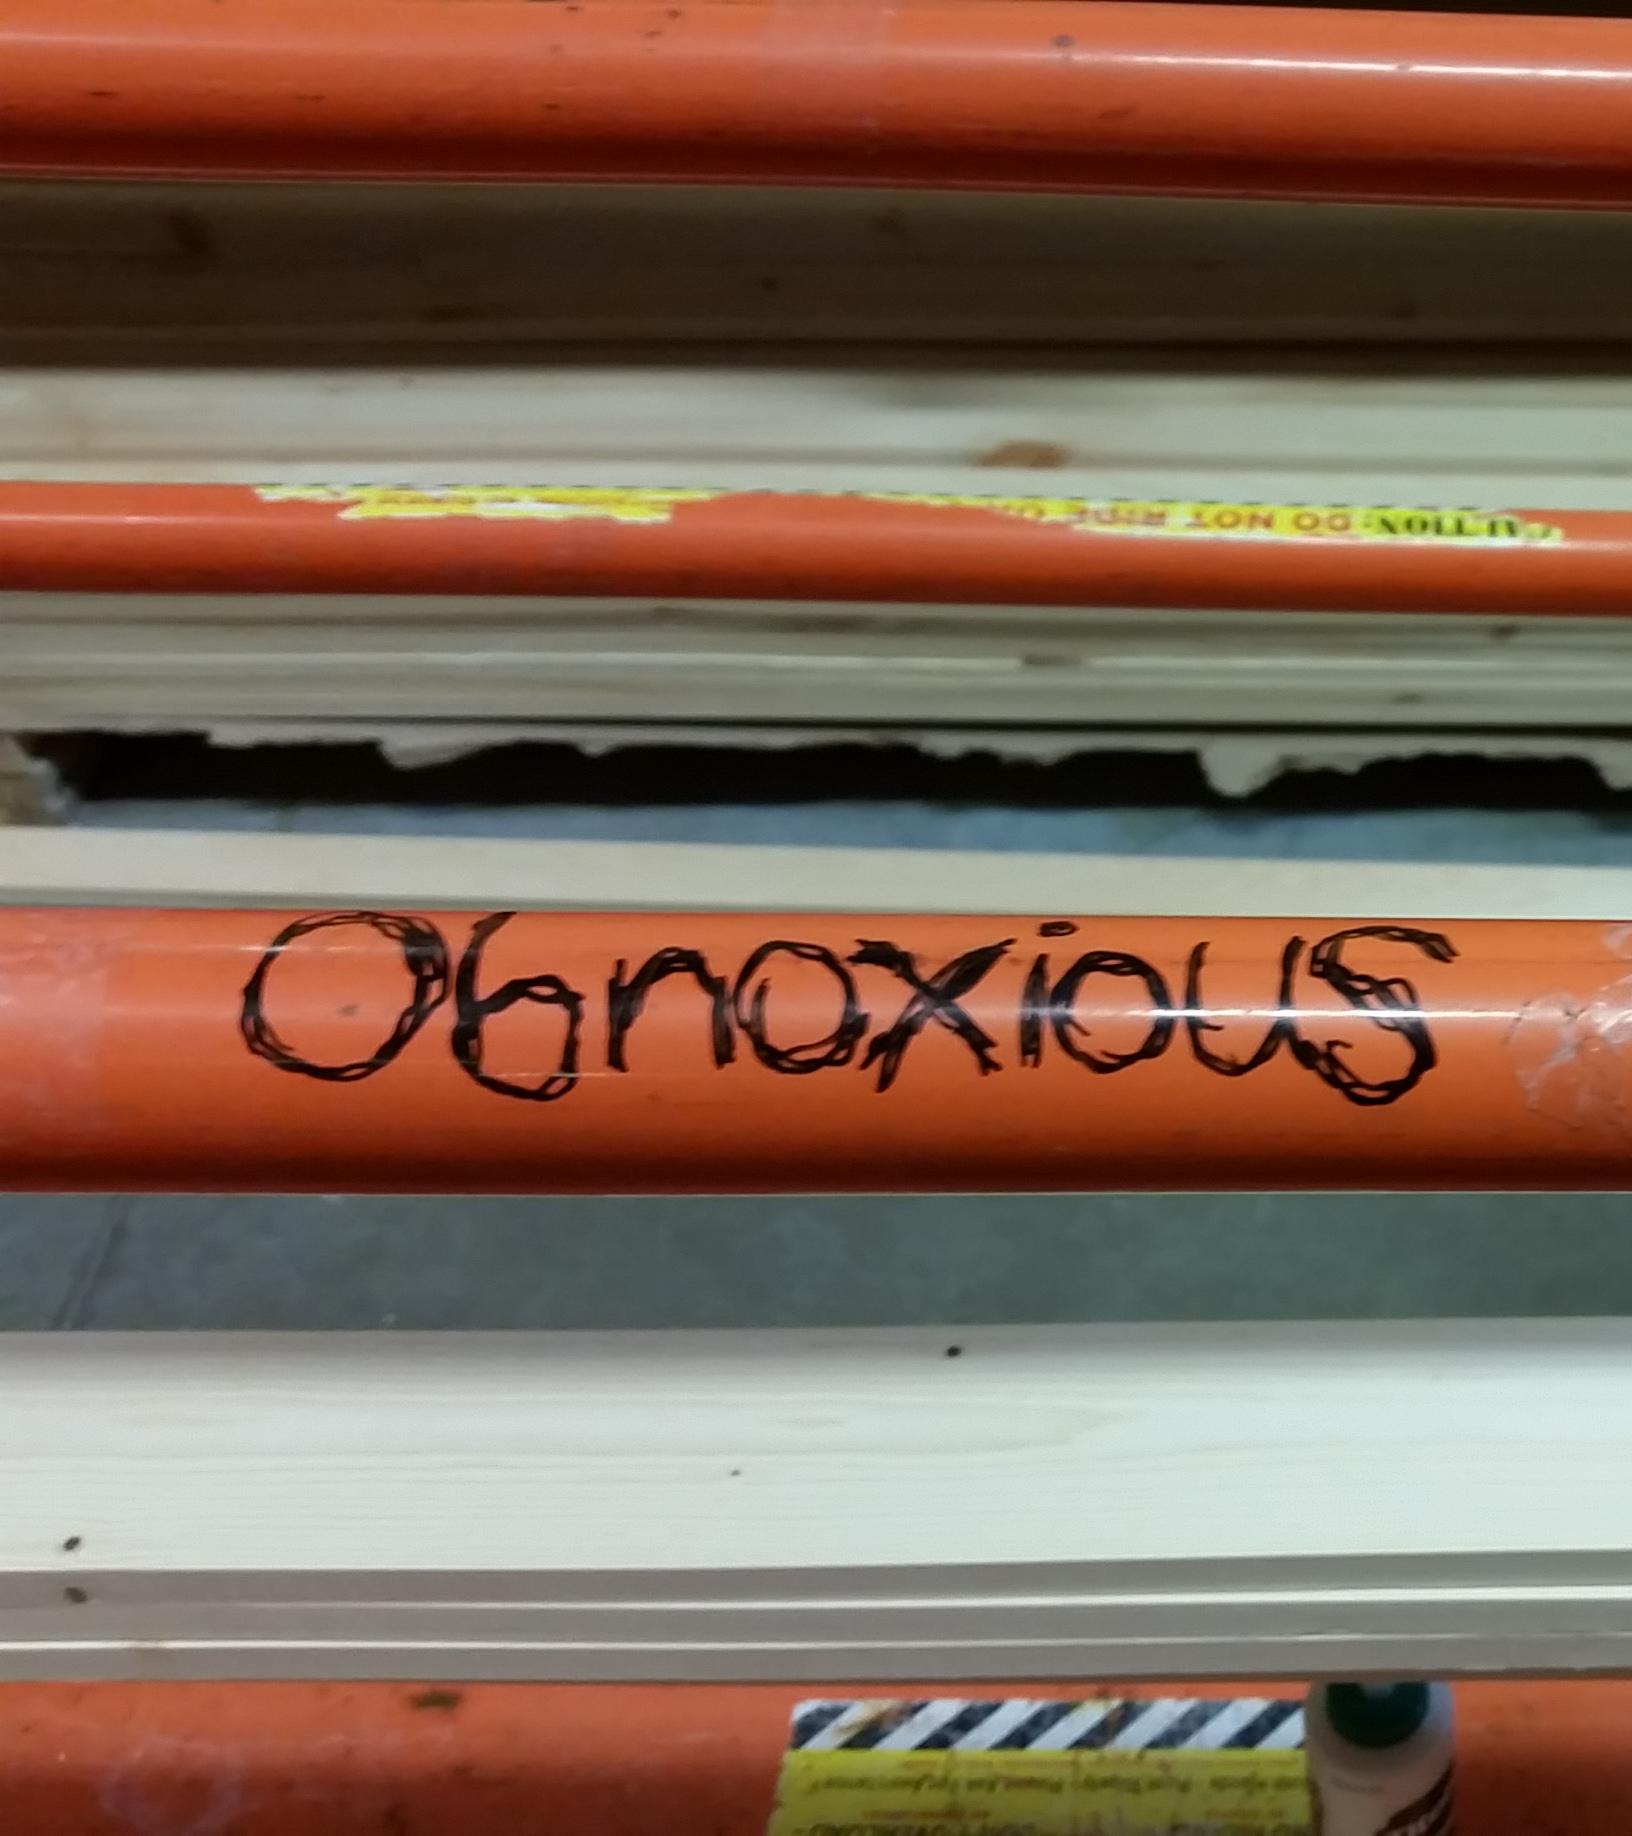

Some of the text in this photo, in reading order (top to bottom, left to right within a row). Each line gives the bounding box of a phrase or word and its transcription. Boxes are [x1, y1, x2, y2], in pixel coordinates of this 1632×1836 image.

[1187, 510, 1275, 531] NOT
[1293, 512, 1351, 533] DO
[240, 911, 1455, 1106] Obnoxious
